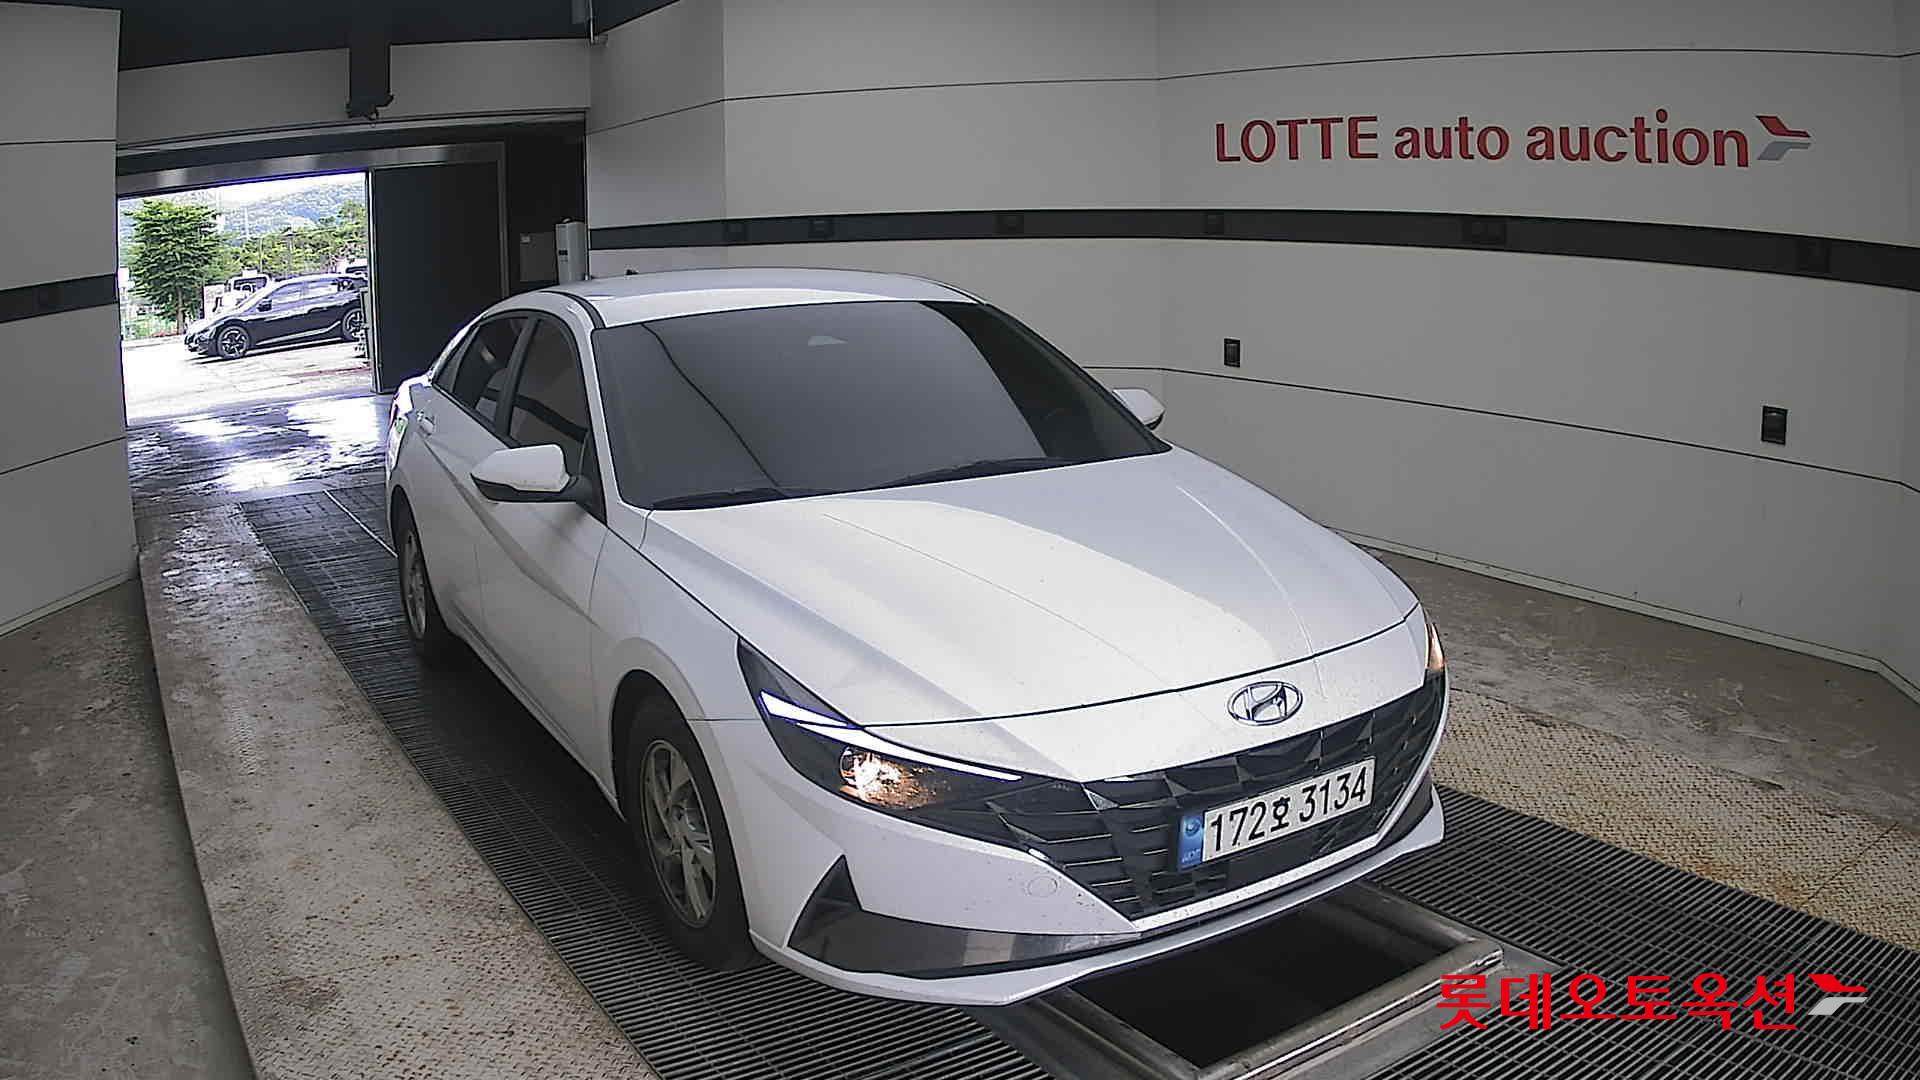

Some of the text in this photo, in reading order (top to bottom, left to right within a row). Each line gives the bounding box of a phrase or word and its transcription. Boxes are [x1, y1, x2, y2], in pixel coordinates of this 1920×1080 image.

[1215, 109, 1750, 168] LOTTE auto auction
[1210, 766, 1367, 852] 172호 3134
